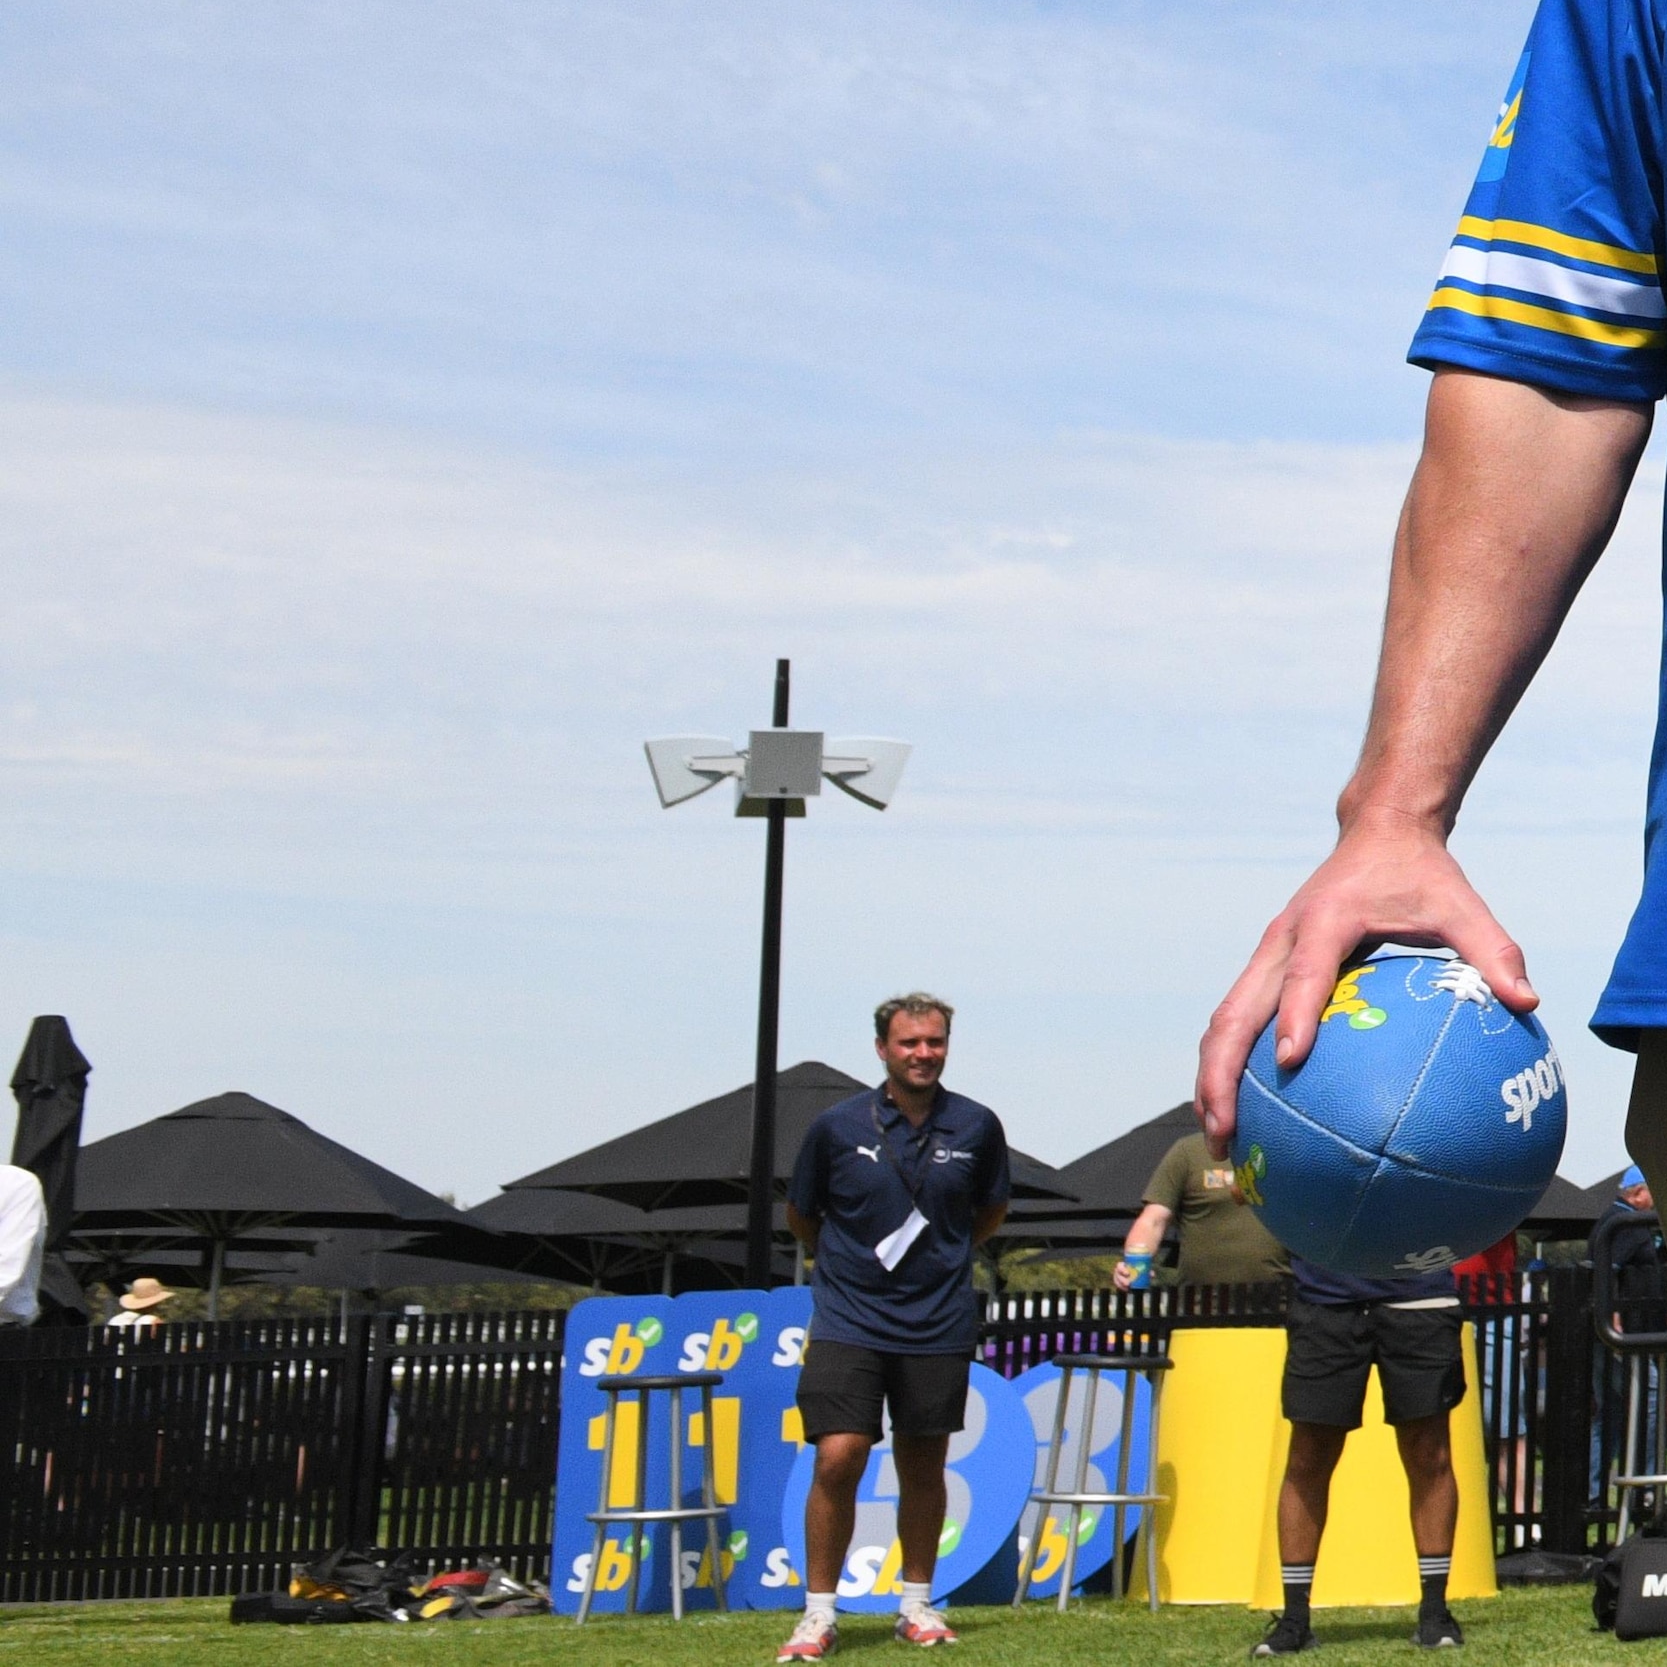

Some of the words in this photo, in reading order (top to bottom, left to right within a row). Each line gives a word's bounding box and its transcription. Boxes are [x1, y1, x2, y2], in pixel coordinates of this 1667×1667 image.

[579, 1323, 645, 1376] sb
[678, 1318, 743, 1372] sb
[772, 1327, 808, 1366] s
